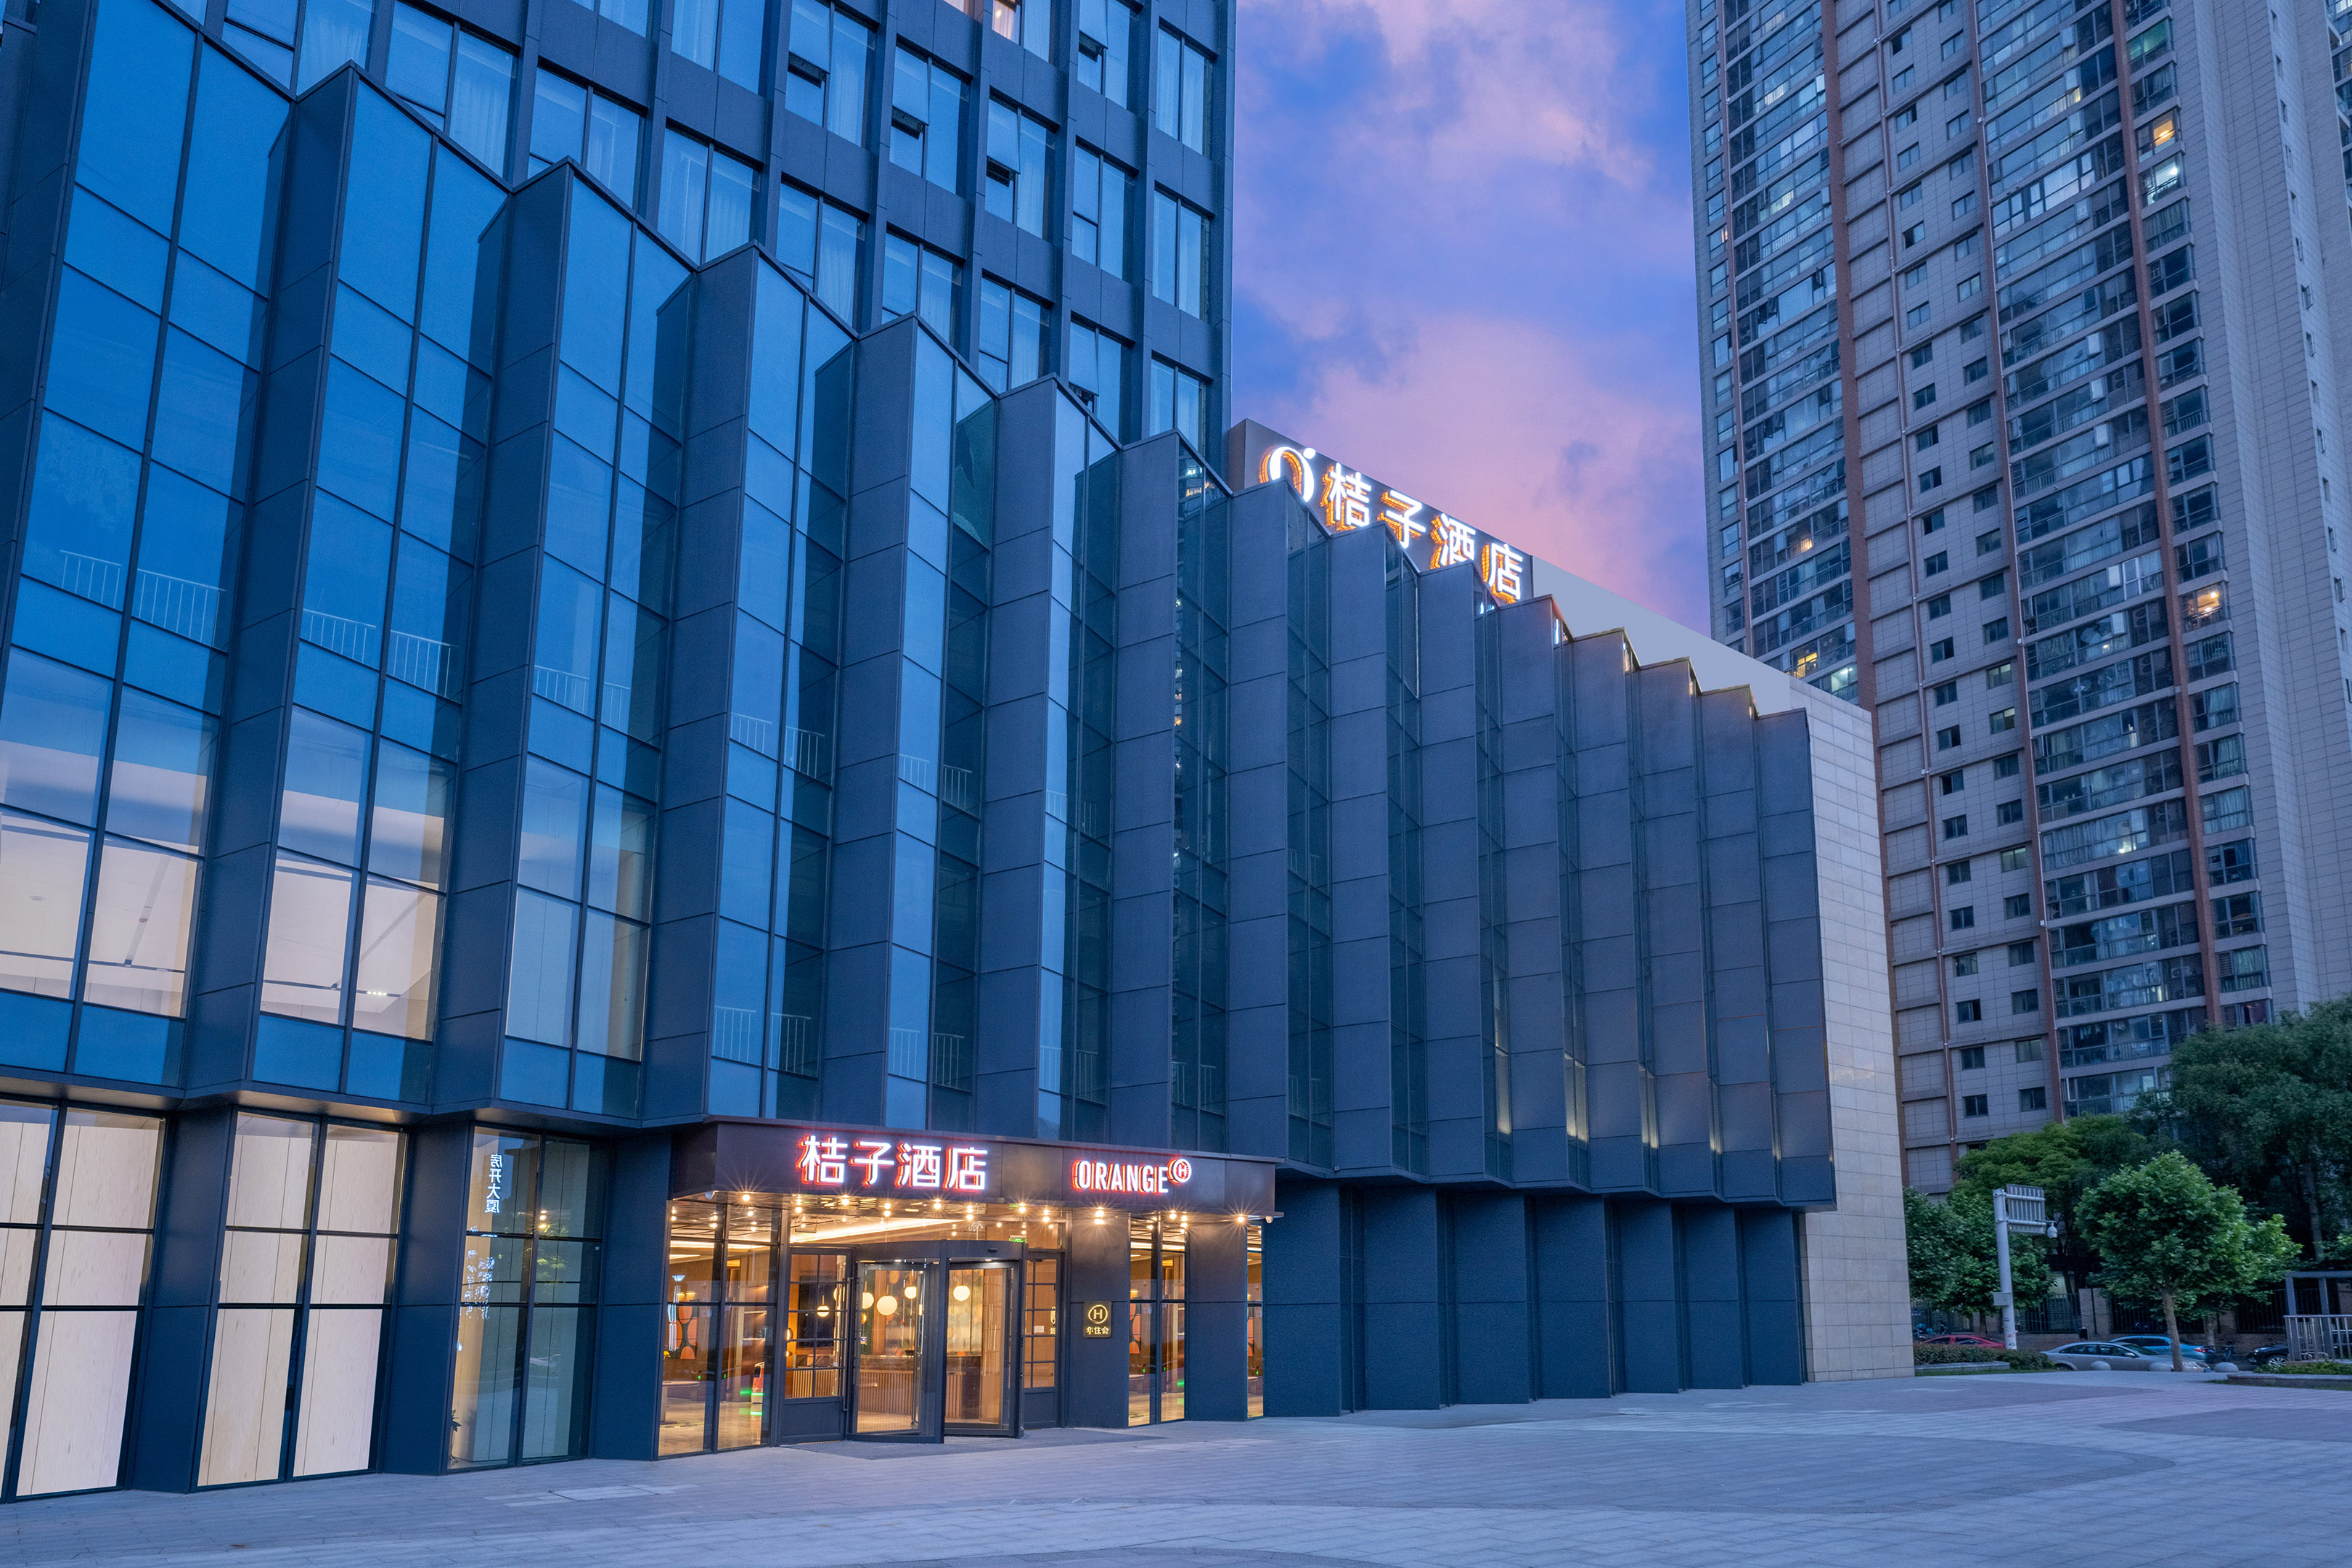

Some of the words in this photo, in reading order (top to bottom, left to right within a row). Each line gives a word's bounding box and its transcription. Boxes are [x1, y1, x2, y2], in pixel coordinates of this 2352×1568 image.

[1326, 462, 1524, 601] 桔子酒店
[800, 1135, 988, 1191] 桔子酒店
[1076, 1160, 1169, 1193] ORANGE
[1086, 1326, 1109, 1335] 华住会
